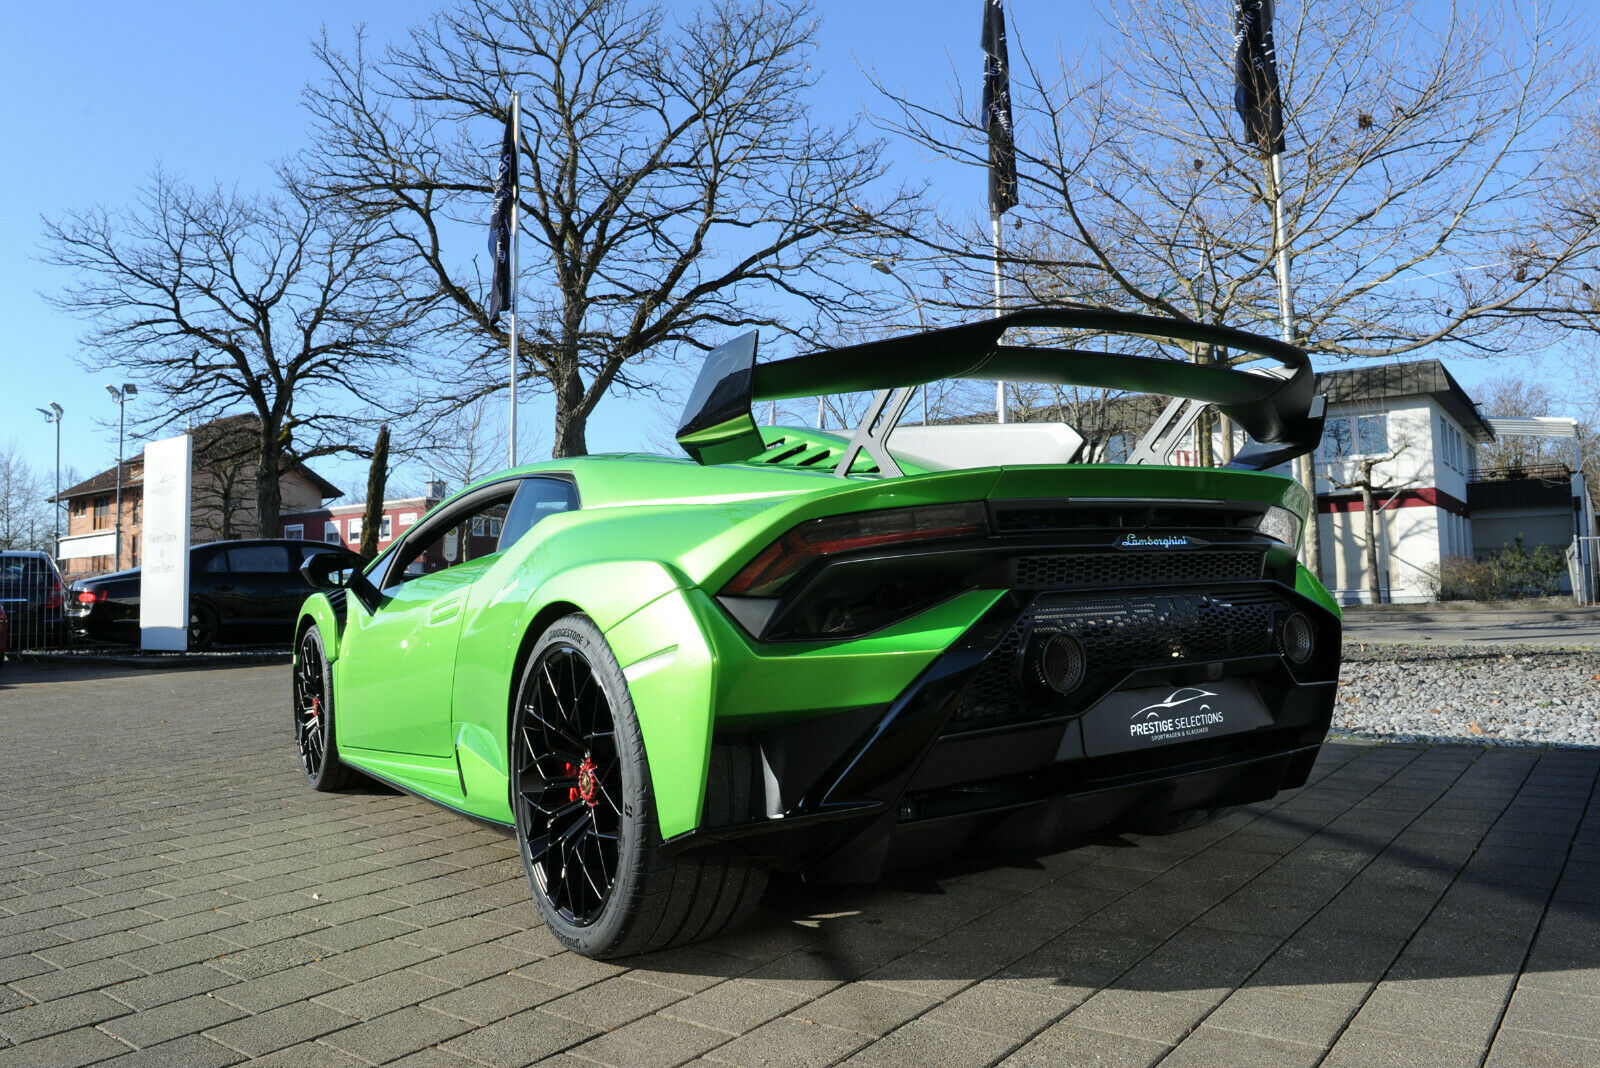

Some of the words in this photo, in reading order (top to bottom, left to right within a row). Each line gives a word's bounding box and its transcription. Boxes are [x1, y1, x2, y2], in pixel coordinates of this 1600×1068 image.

[1122, 534, 1188, 548] Lamborghini
[1130, 719, 1174, 736] PRESTIGE
[1174, 711, 1224, 730] SELECTIONS
[1151, 732, 1181, 742] SPORTWAGEN
